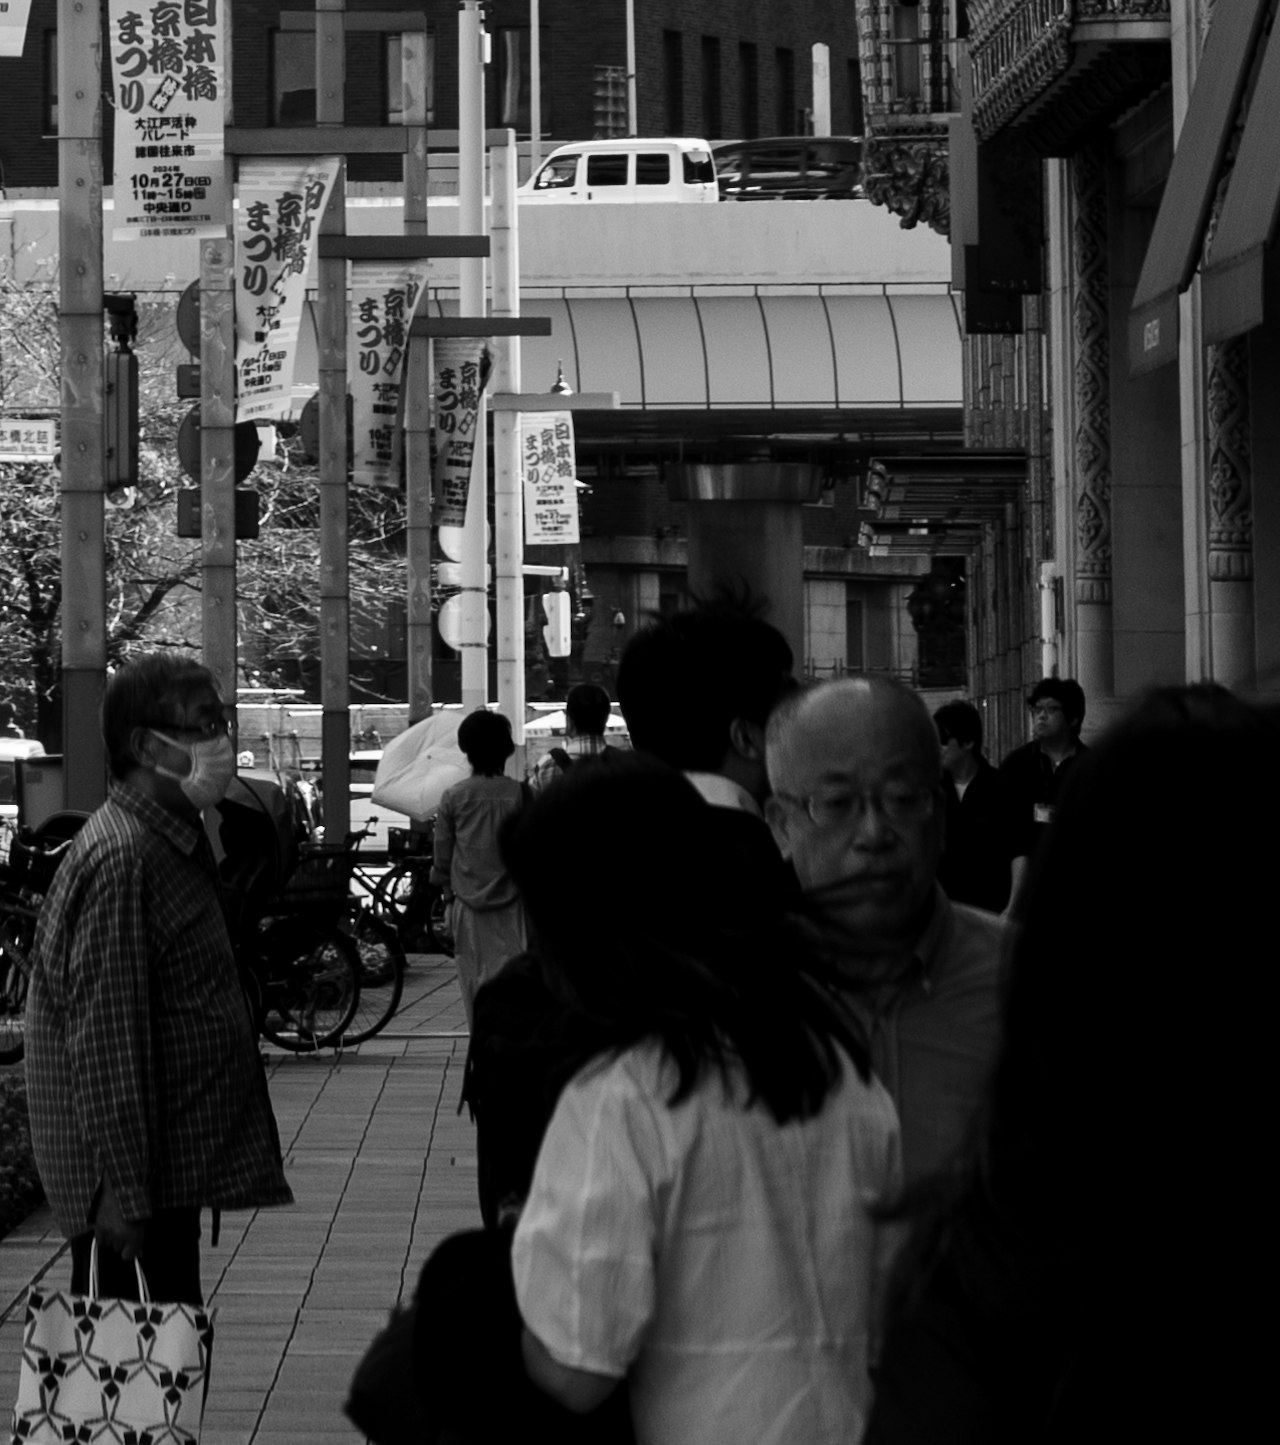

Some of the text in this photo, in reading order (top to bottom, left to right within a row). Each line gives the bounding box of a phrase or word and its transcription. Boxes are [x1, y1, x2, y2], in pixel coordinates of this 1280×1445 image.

[115, 11, 148, 115] まつり
[148, 0, 183, 75] 京橋
[142, 129, 190, 142] パレード
[243, 200, 273, 297] まつり
[356, 296, 382, 376] まつり
[437, 367, 459, 434] まつり
[525, 433, 541, 484] まつり
[541, 428, 555, 465] 京橋
[555, 422, 572, 478] 日本橋
